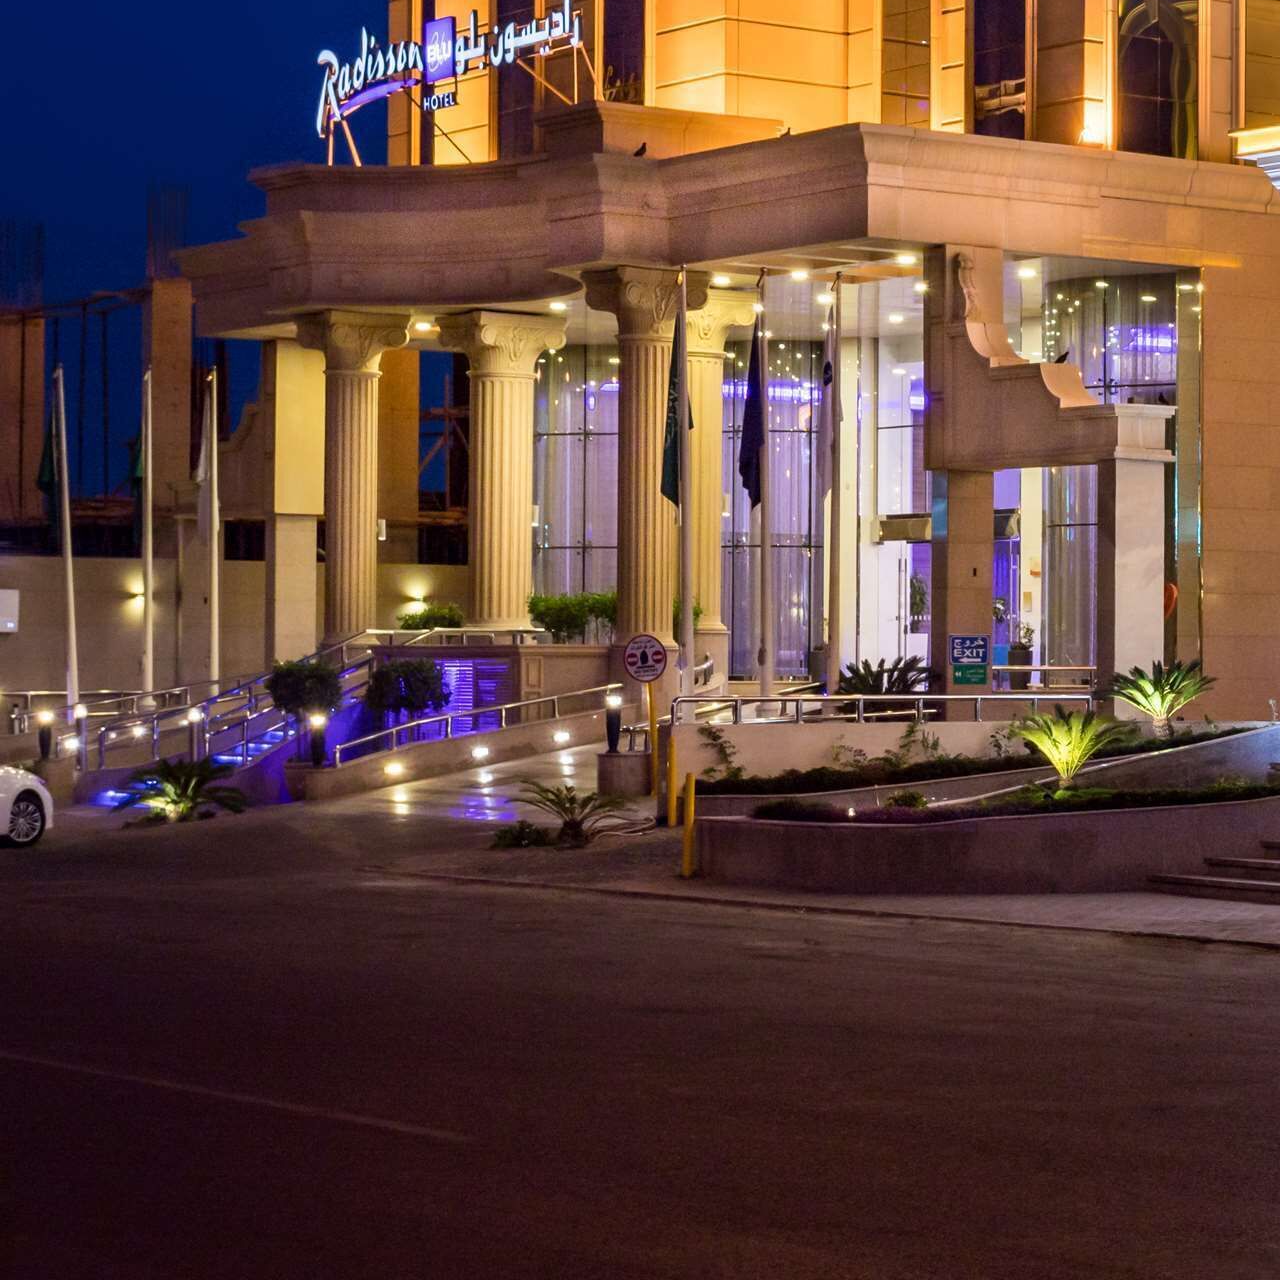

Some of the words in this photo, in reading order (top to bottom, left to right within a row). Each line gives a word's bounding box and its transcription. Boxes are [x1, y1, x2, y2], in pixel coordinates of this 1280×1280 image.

[455, 9, 485, 74] بلو
[317, 26, 423, 138] Radisson
[424, 93, 455, 111] HOTEL
[954, 637, 985, 648] خروج
[954, 648, 985, 657] EXIT
